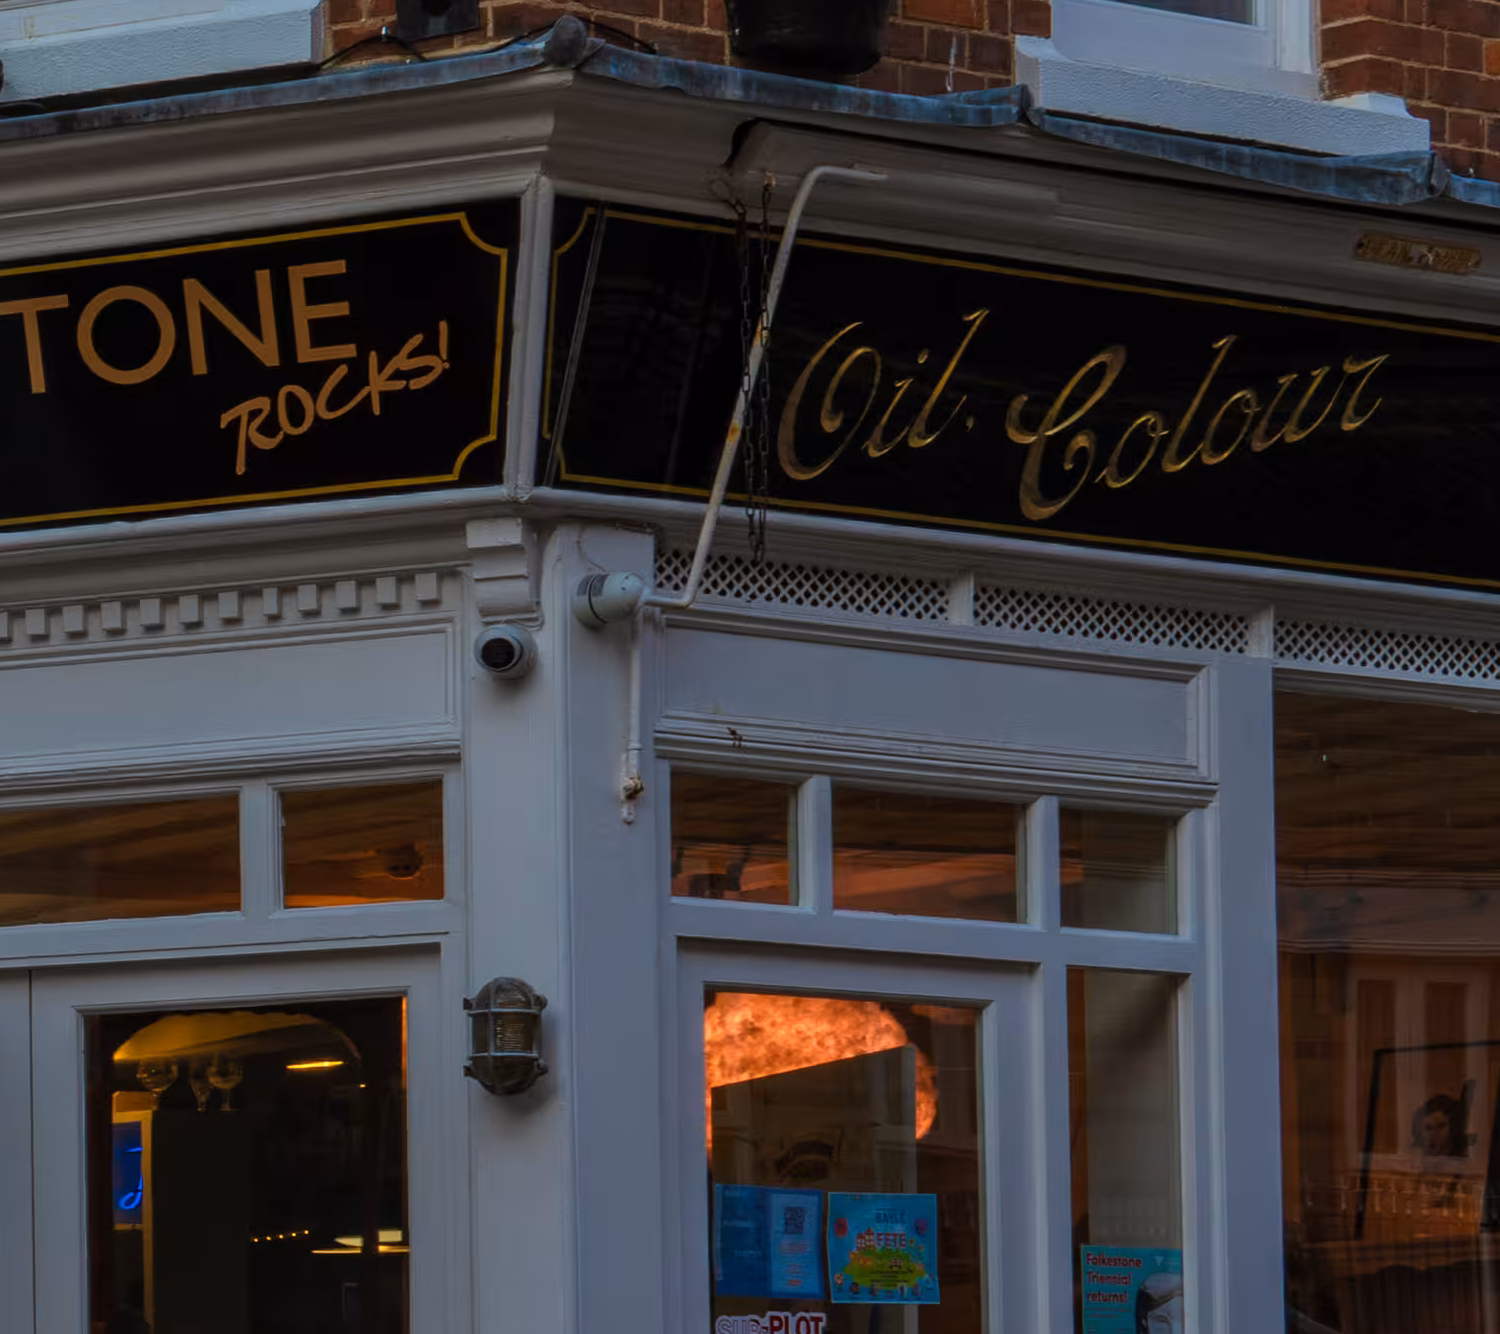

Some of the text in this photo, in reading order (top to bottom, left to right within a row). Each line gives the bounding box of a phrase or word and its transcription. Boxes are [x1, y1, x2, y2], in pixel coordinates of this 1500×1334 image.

[221, 321, 450, 475] ROCKS!
[1006, 334, 1391, 521] Colour
[1086, 1252, 1143, 1268] Folkestone
[1086, 1271, 1133, 1286] Triennial
